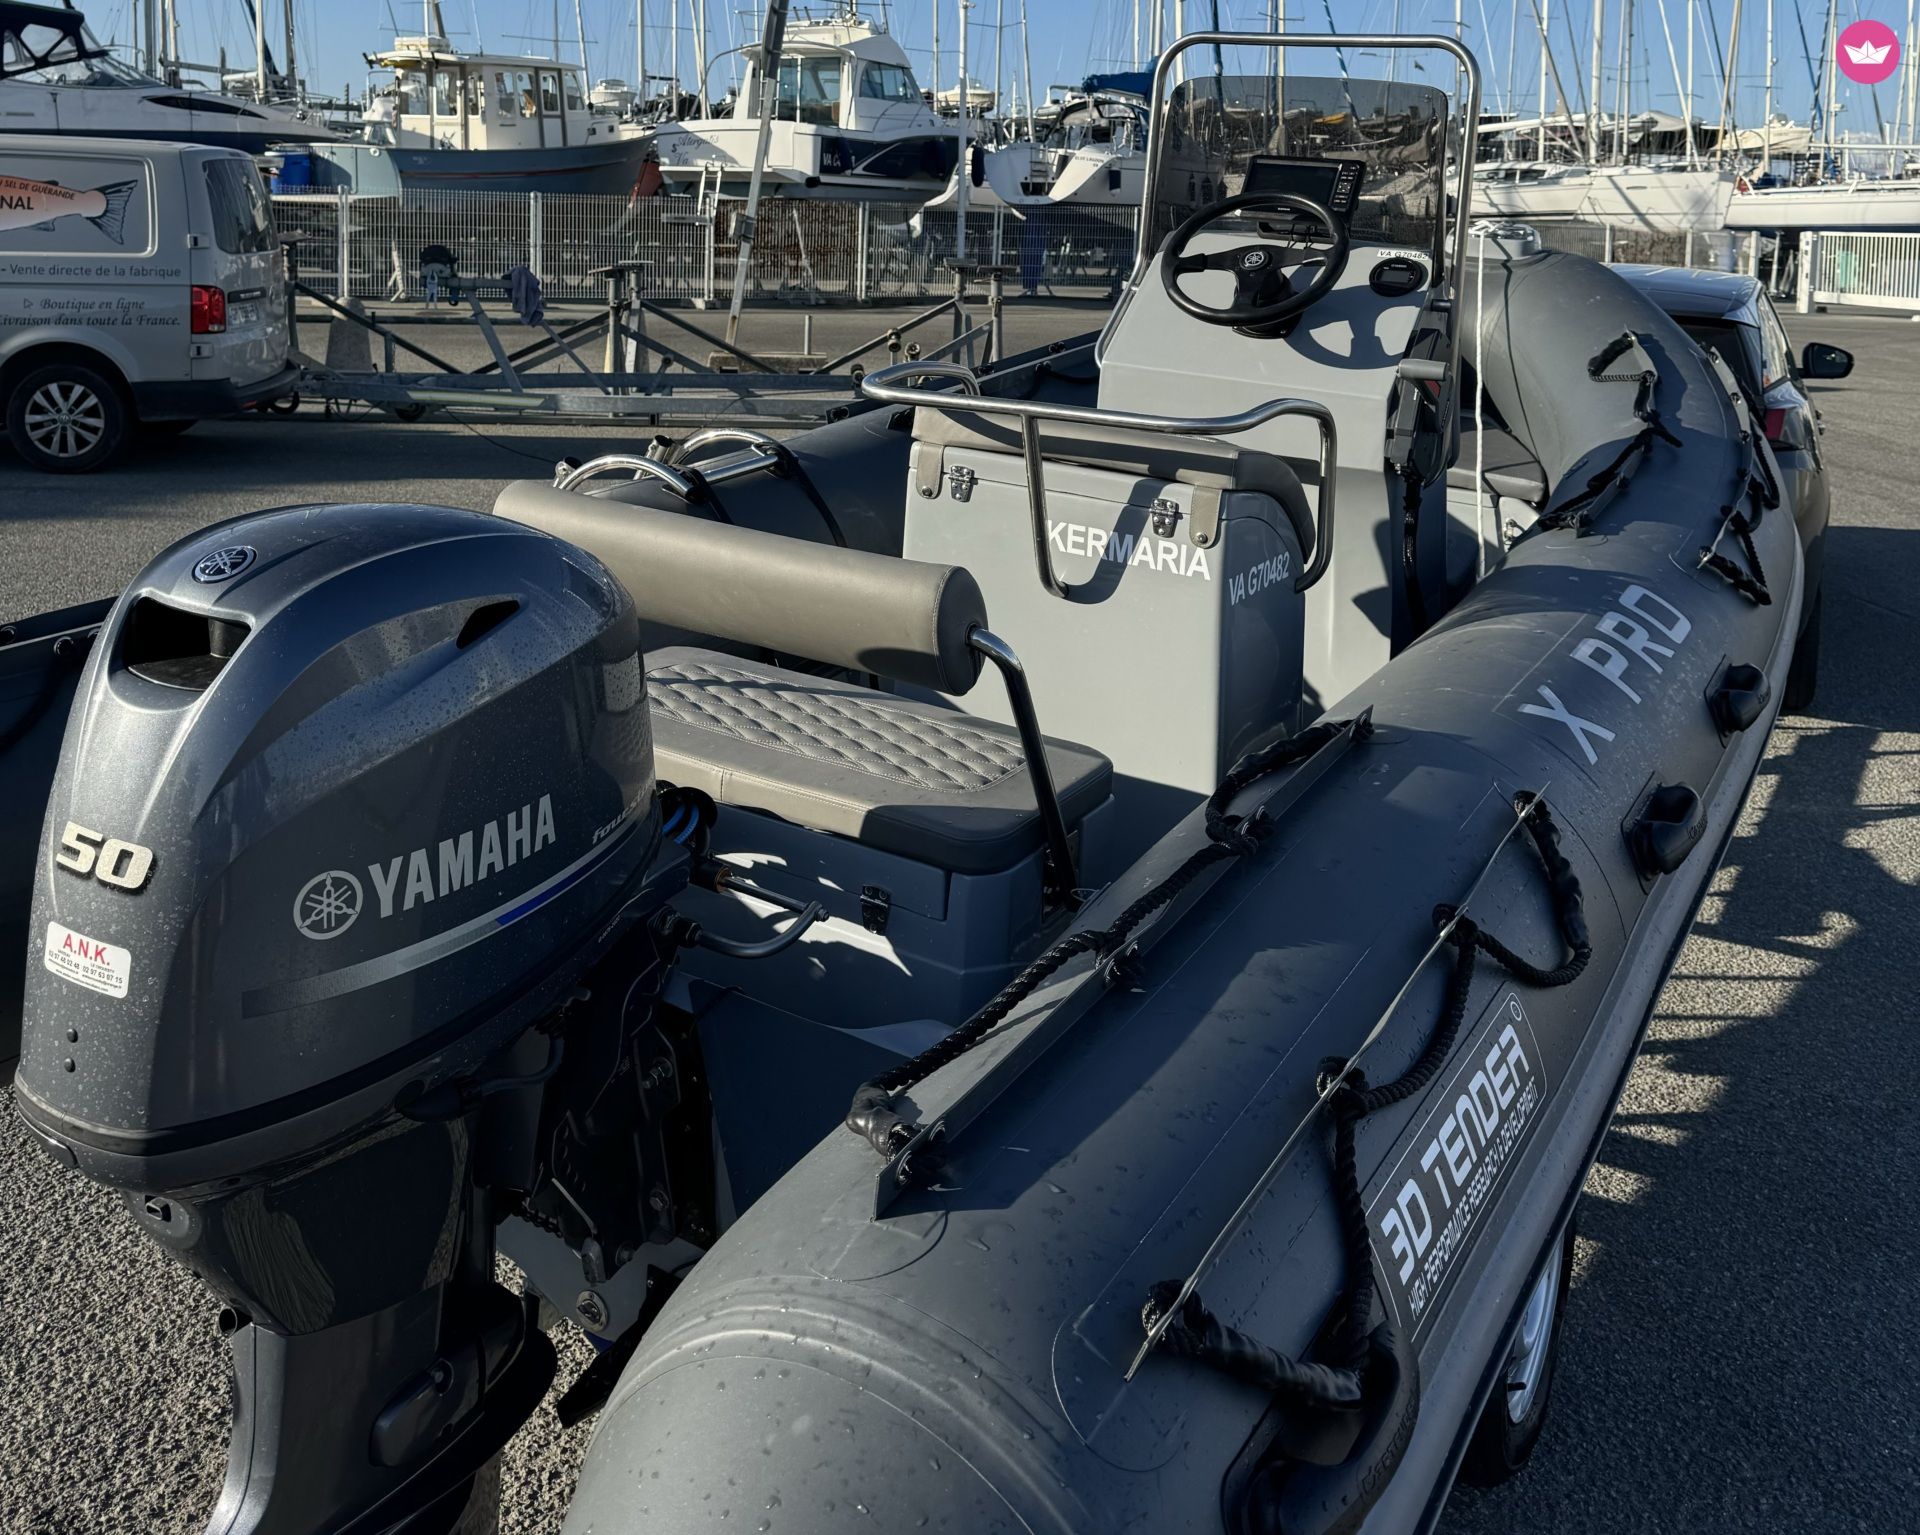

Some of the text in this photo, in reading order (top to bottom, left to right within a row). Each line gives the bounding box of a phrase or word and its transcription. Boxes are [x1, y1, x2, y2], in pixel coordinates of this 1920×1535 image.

[4, 180, 17, 188] SEL
[19, 182, 29, 192] DE
[31, 184, 75, 201] GUÉRANDE
[10, 264, 45, 275] Vente
[49, 264, 92, 276] directe
[95, 265, 111, 276] de
[115, 265, 126, 276] la
[130, 265, 182, 280] fabrique
[1395, 251, 1428, 260] G70482
[40, 297, 145, 313] Boutique en ligne
[54, 313, 83, 326] dans
[86, 315, 120, 326] toute
[121, 313, 132, 326] la
[136, 314, 181, 326] France.
[1047, 520, 1211, 581] KERMARIA
[1229, 551, 1290, 606] VA G70482
[1517, 584, 1692, 766] X PRO
[56, 821, 153, 889] 50
[368, 793, 556, 919] YAMAHA
[63, 933, 110, 966] A.N.K.
[1380, 1024, 1530, 1286] 3D TENDER
[1407, 1271, 1429, 1321] HIGH
[1424, 1194, 1471, 1292] PERFORMANCE
[1467, 1143, 1501, 1213] RESEARCH
[1500, 1075, 1539, 1154] DEVELOPMENT
